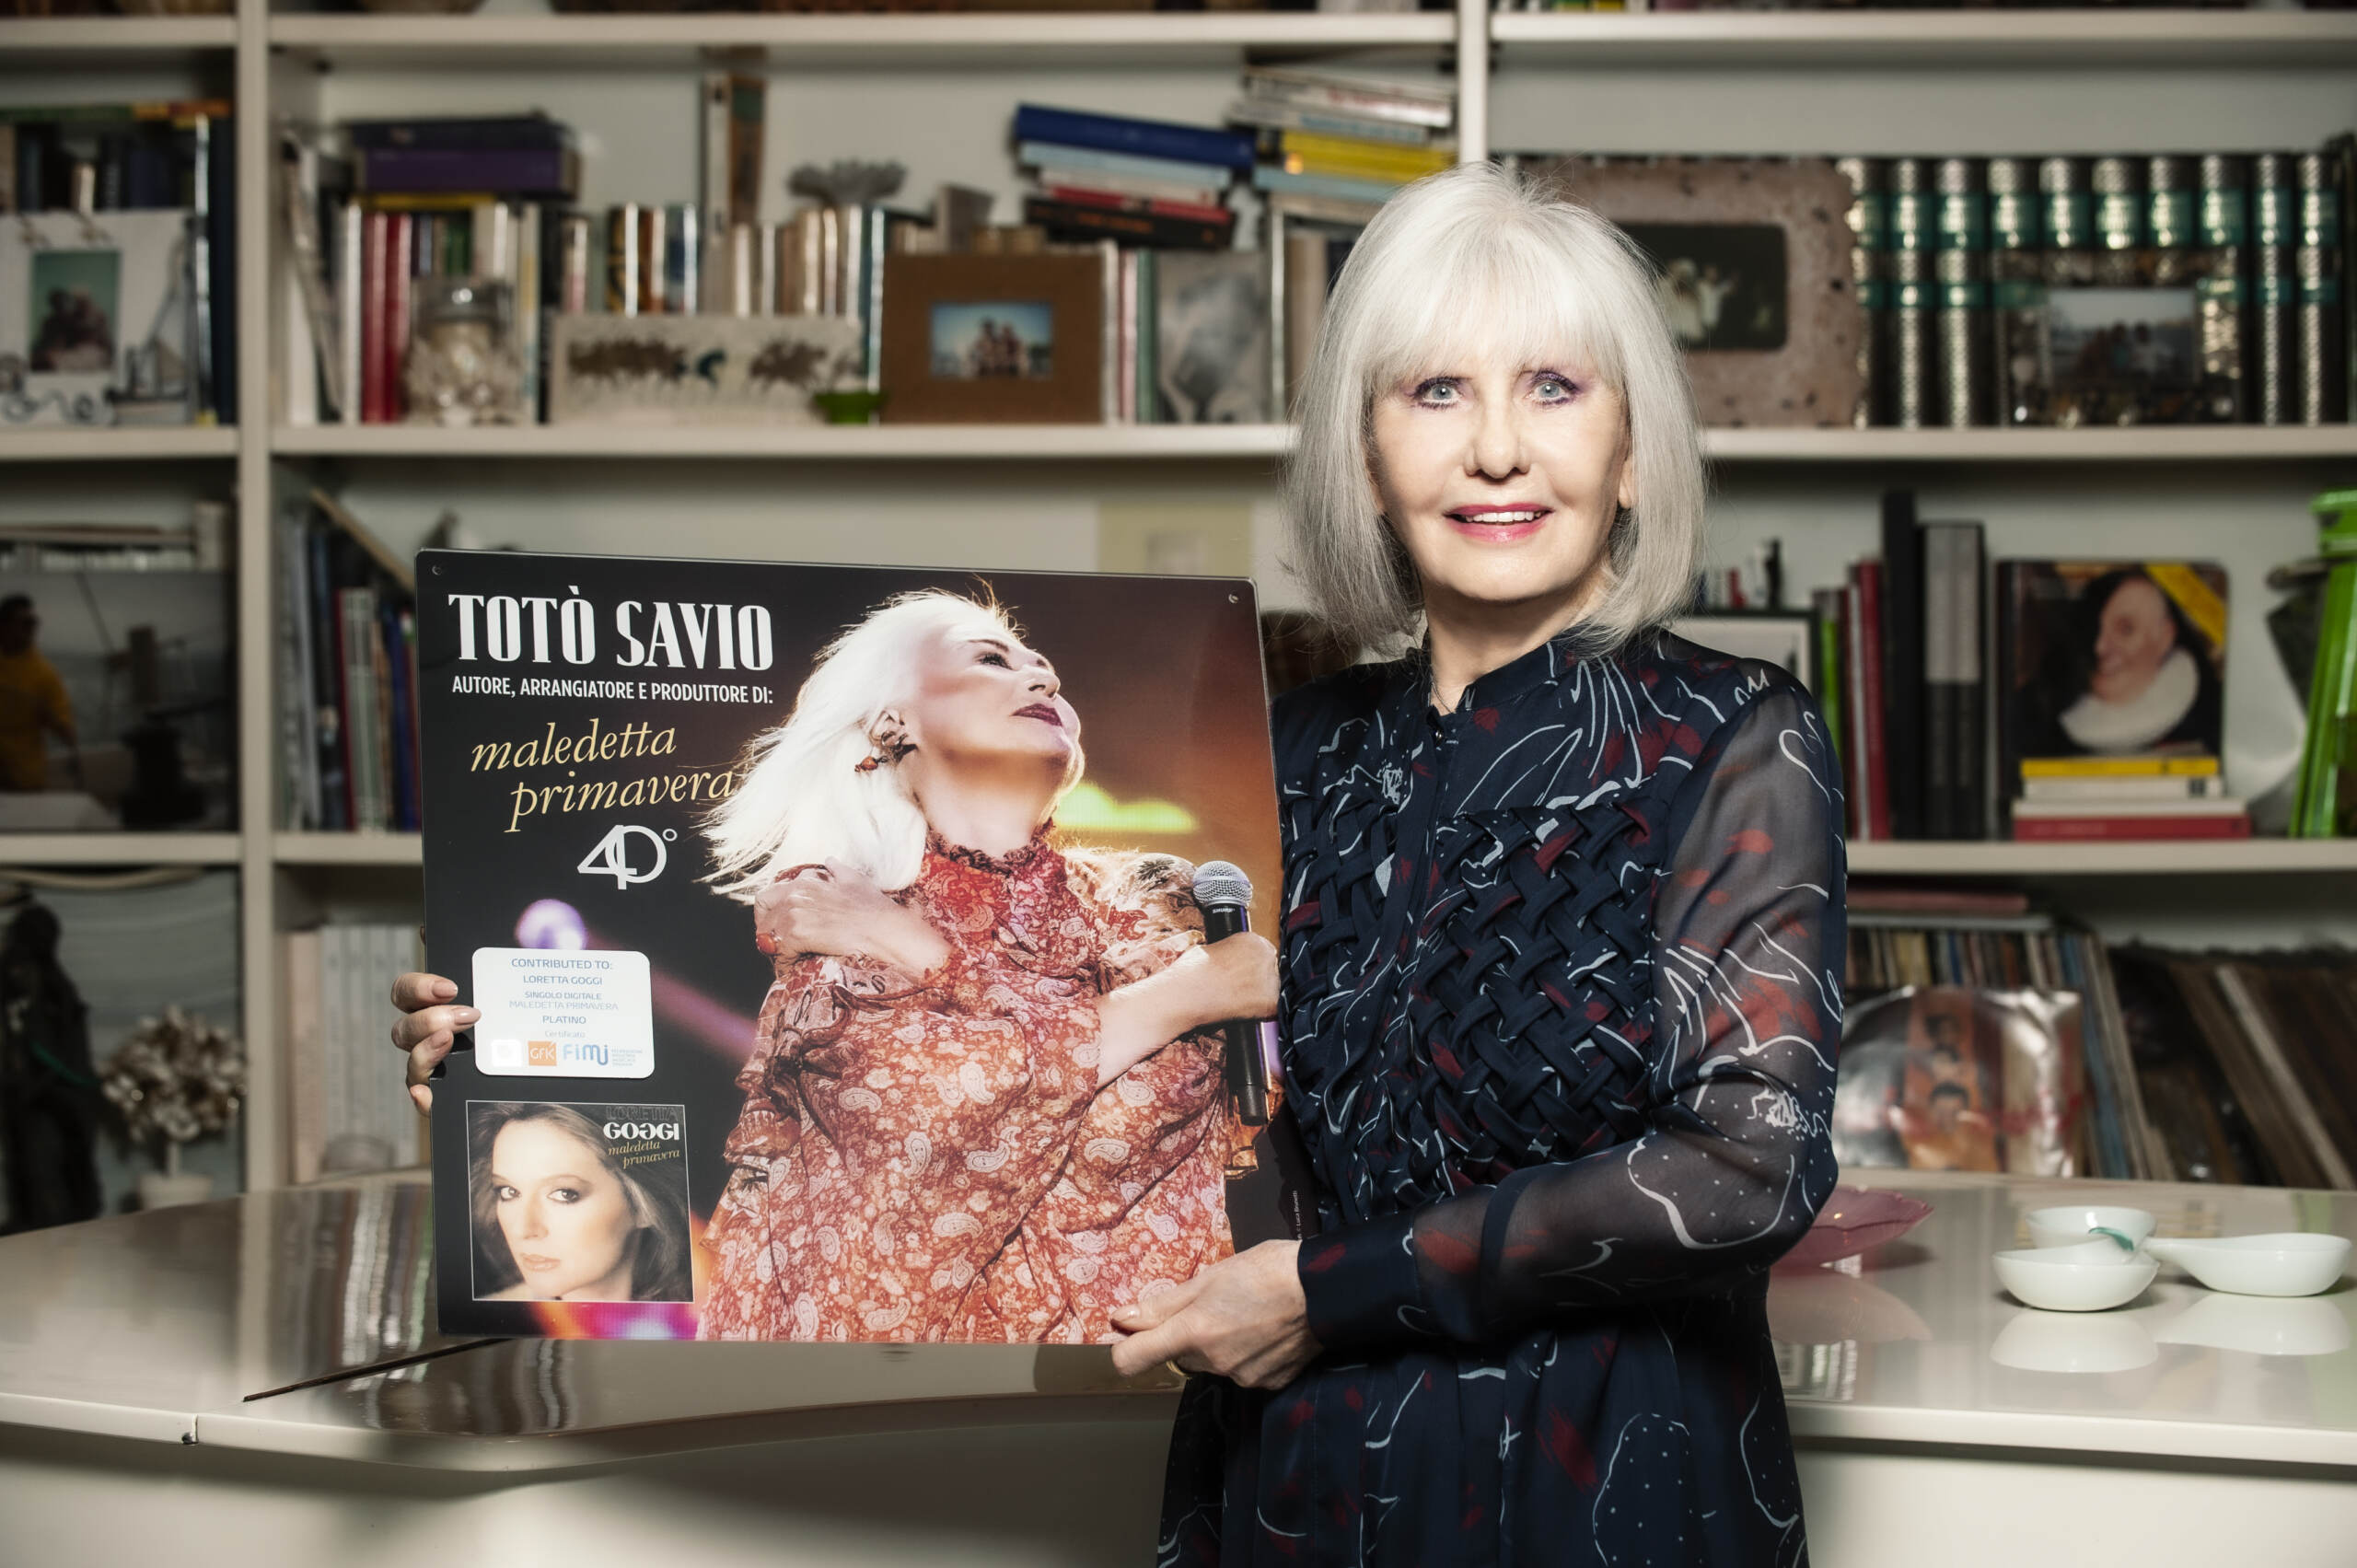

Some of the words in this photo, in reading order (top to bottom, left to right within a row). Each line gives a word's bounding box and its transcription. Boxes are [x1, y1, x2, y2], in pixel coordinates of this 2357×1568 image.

[447, 584, 597, 666] TOTÒ
[615, 599, 773, 671] SAVIO
[452, 675, 516, 698] AUTORE,
[519, 678, 635, 700] ARRANGIATORE
[639, 682, 647, 700] E
[651, 682, 749, 703] PRODUTTORE
[752, 686, 773, 704] DI:
[470, 718, 677, 772] maledetta
[504, 770, 736, 833] primavera
[511, 958, 592, 970] CONTRIBUTED
[594, 960, 612, 970] TO:
[523, 975, 569, 984] LORETTA
[571, 976, 603, 985] GOGGI
[524, 991, 563, 999] SINGOLO
[563, 992, 602, 1000] DIGITALE
[509, 1001, 564, 1009] MALEDETTA
[566, 1002, 619, 1010] PRIMAVERA
[542, 1015, 586, 1024] PLATINO
[603, 1121, 679, 1140] GOGGI
[608, 1140, 661, 1156] maledetta
[622, 1149, 680, 1169] primavera
